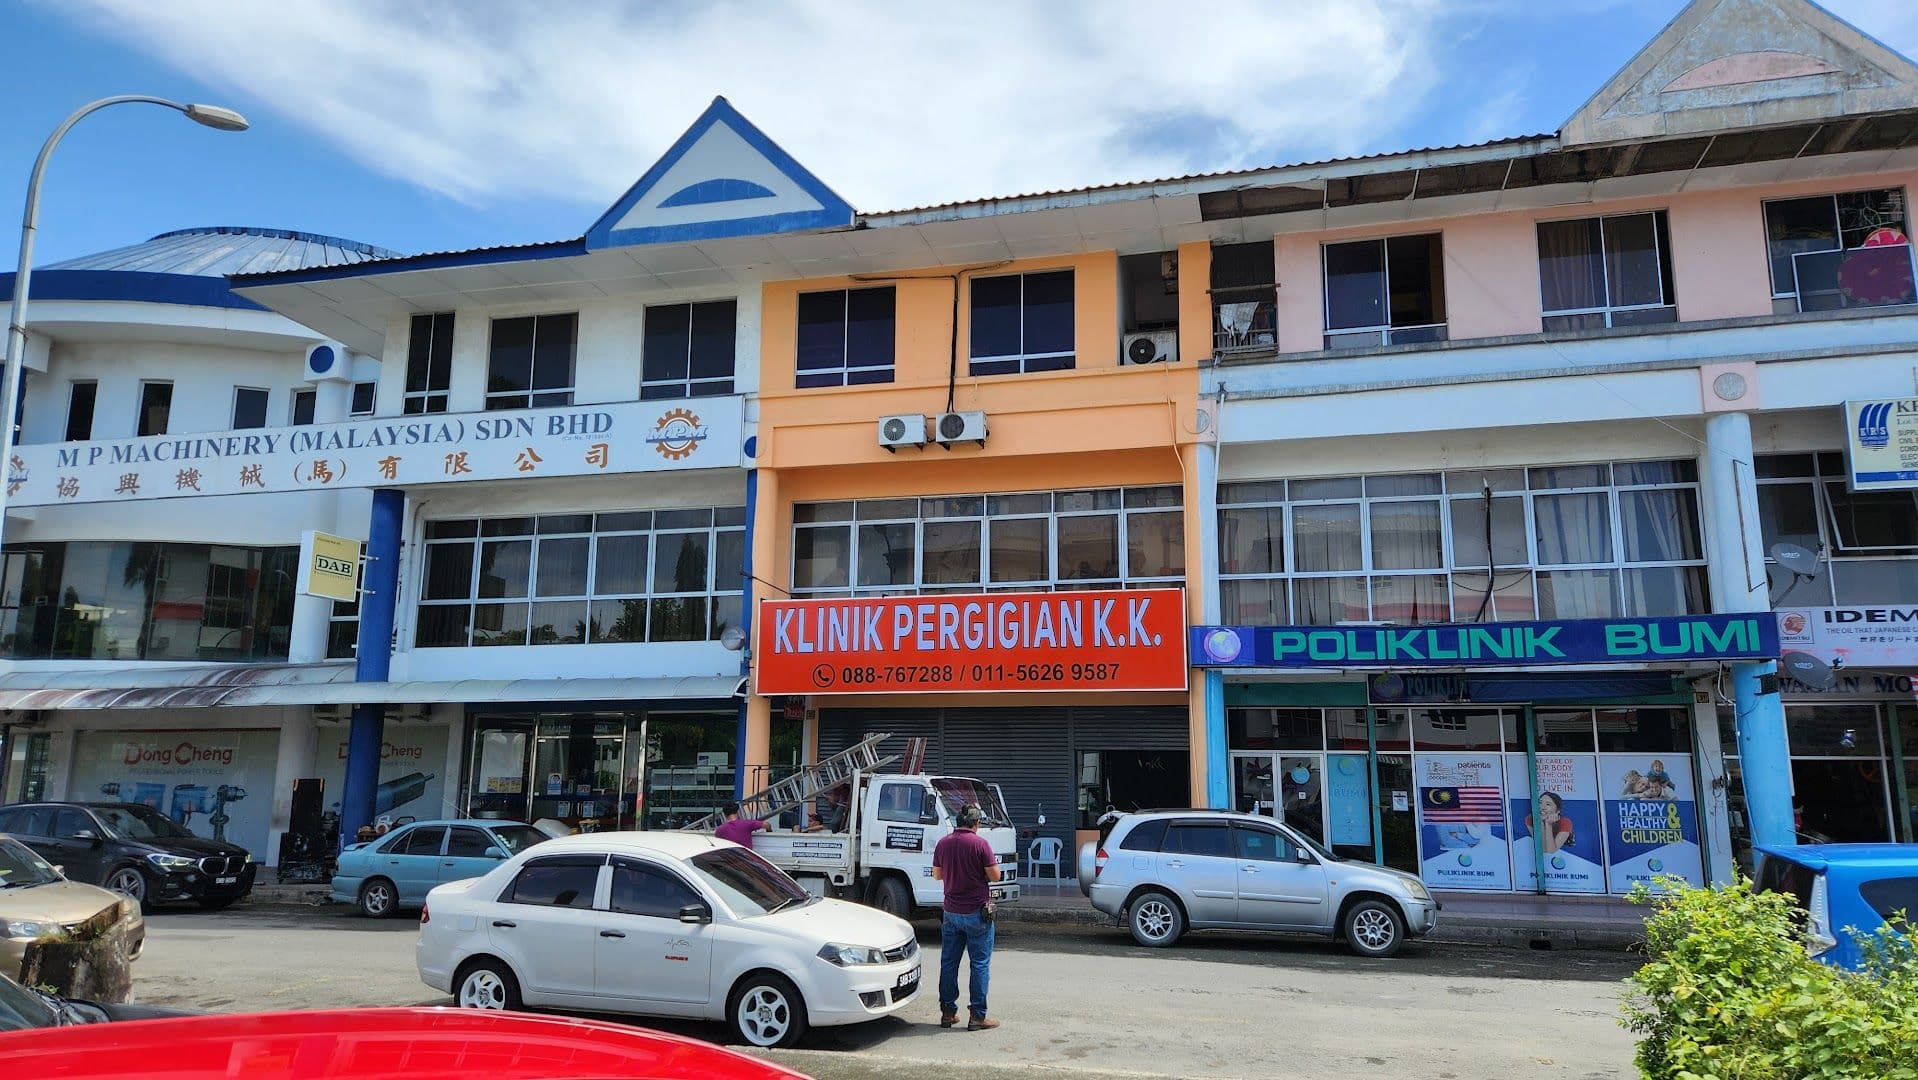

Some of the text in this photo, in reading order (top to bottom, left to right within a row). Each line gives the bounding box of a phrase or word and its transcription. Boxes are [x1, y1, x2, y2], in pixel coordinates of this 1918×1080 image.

[57, 412, 613, 468] M P MACHINERY (MALAYSIA) SDN BHD
[318, 558, 351, 574] DAB
[774, 597, 1162, 655] KLINIK PERGIGIAN K.K.
[1272, 618, 1761, 661] POLIKLINIK BUMI
[842, 664, 953, 685] 088-767288
[972, 663, 1065, 682] 011-5626
[1071, 662, 1120, 681] 9587
[1618, 803, 1681, 829] HAPPY &
[1620, 817, 1667, 829] HEALTHY
[1621, 830, 1683, 843] CHILDREN
[1437, 869, 1475, 877] POLIKLINIK
